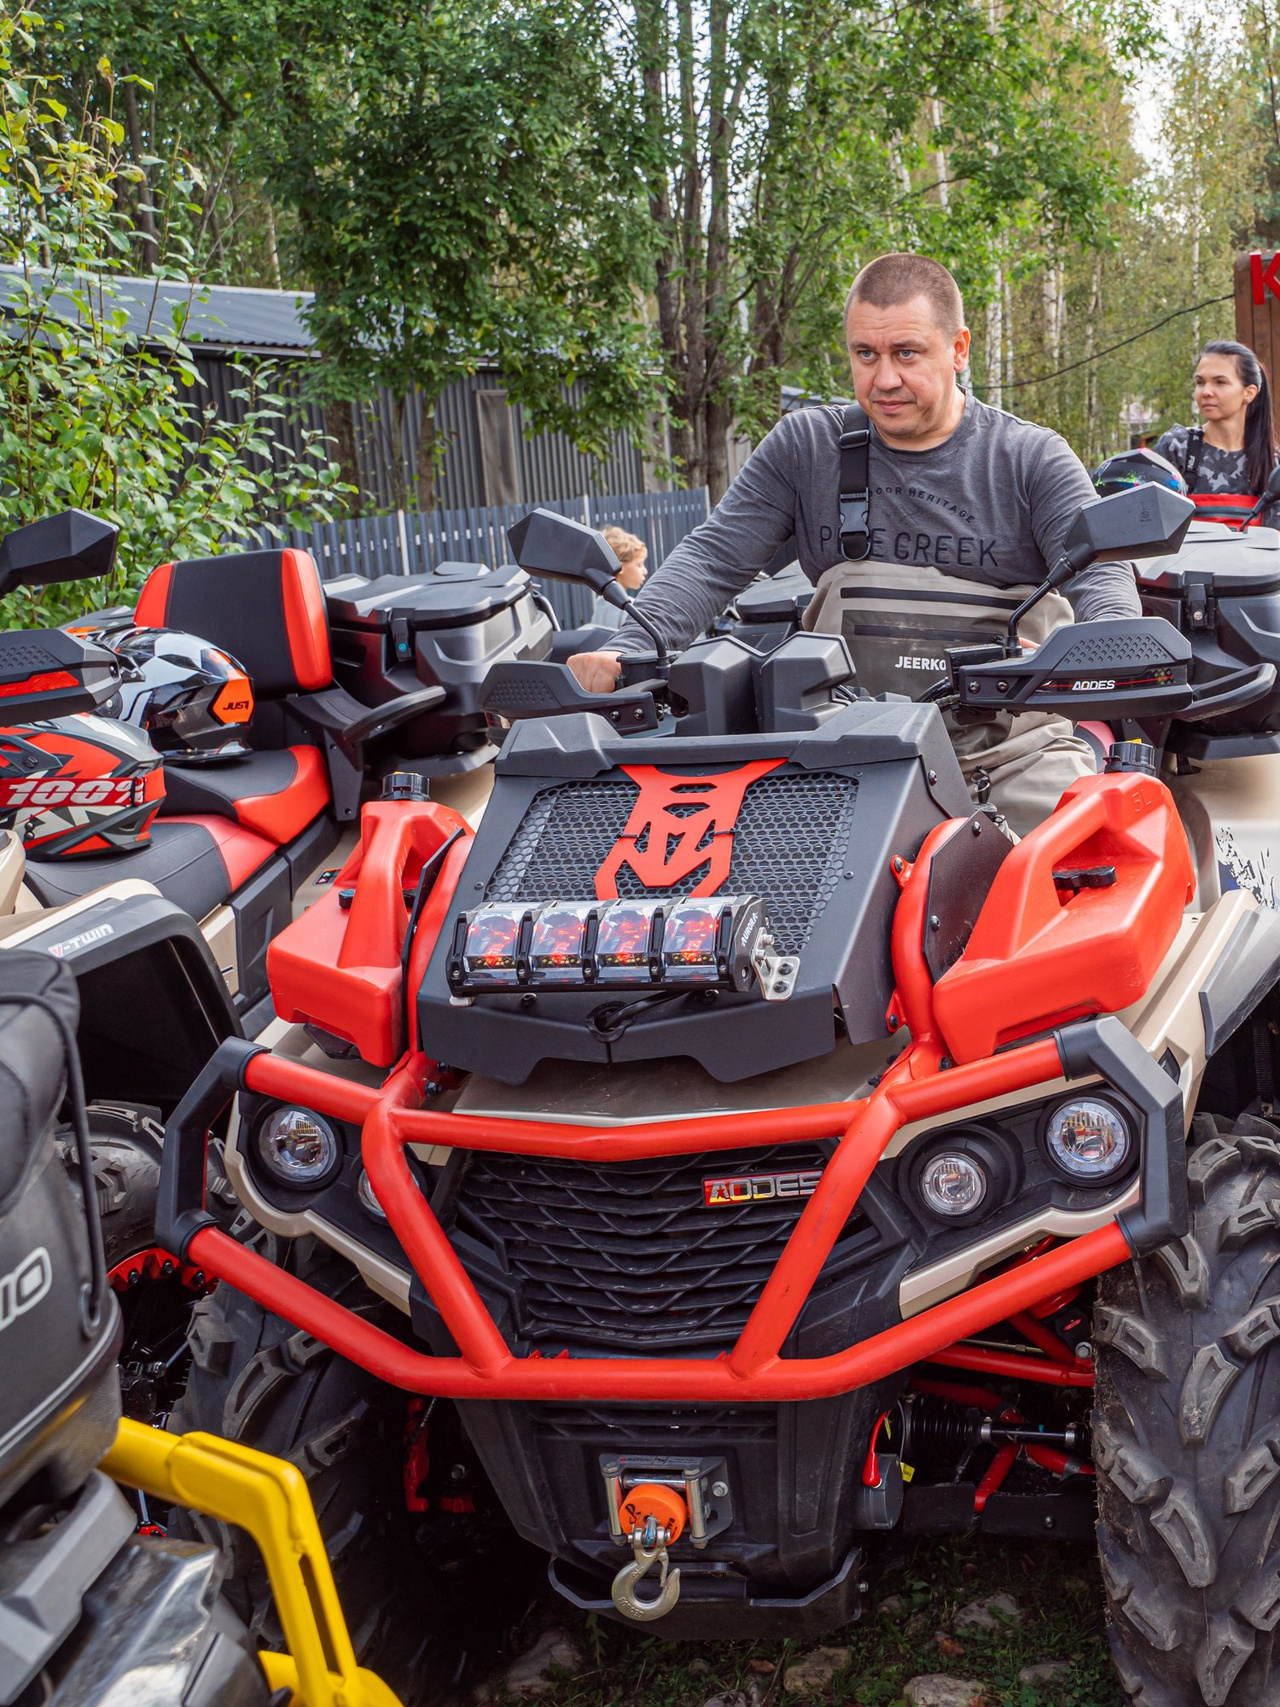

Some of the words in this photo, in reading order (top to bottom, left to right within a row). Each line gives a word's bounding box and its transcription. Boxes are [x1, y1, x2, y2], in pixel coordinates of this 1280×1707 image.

[909, 488, 976, 524] HERITAGE
[894, 532, 998, 567] CREEK
[1072, 680, 1116, 691] AODES
[6, 780, 144, 805] 100%
[709, 1171, 823, 1203] AODES
